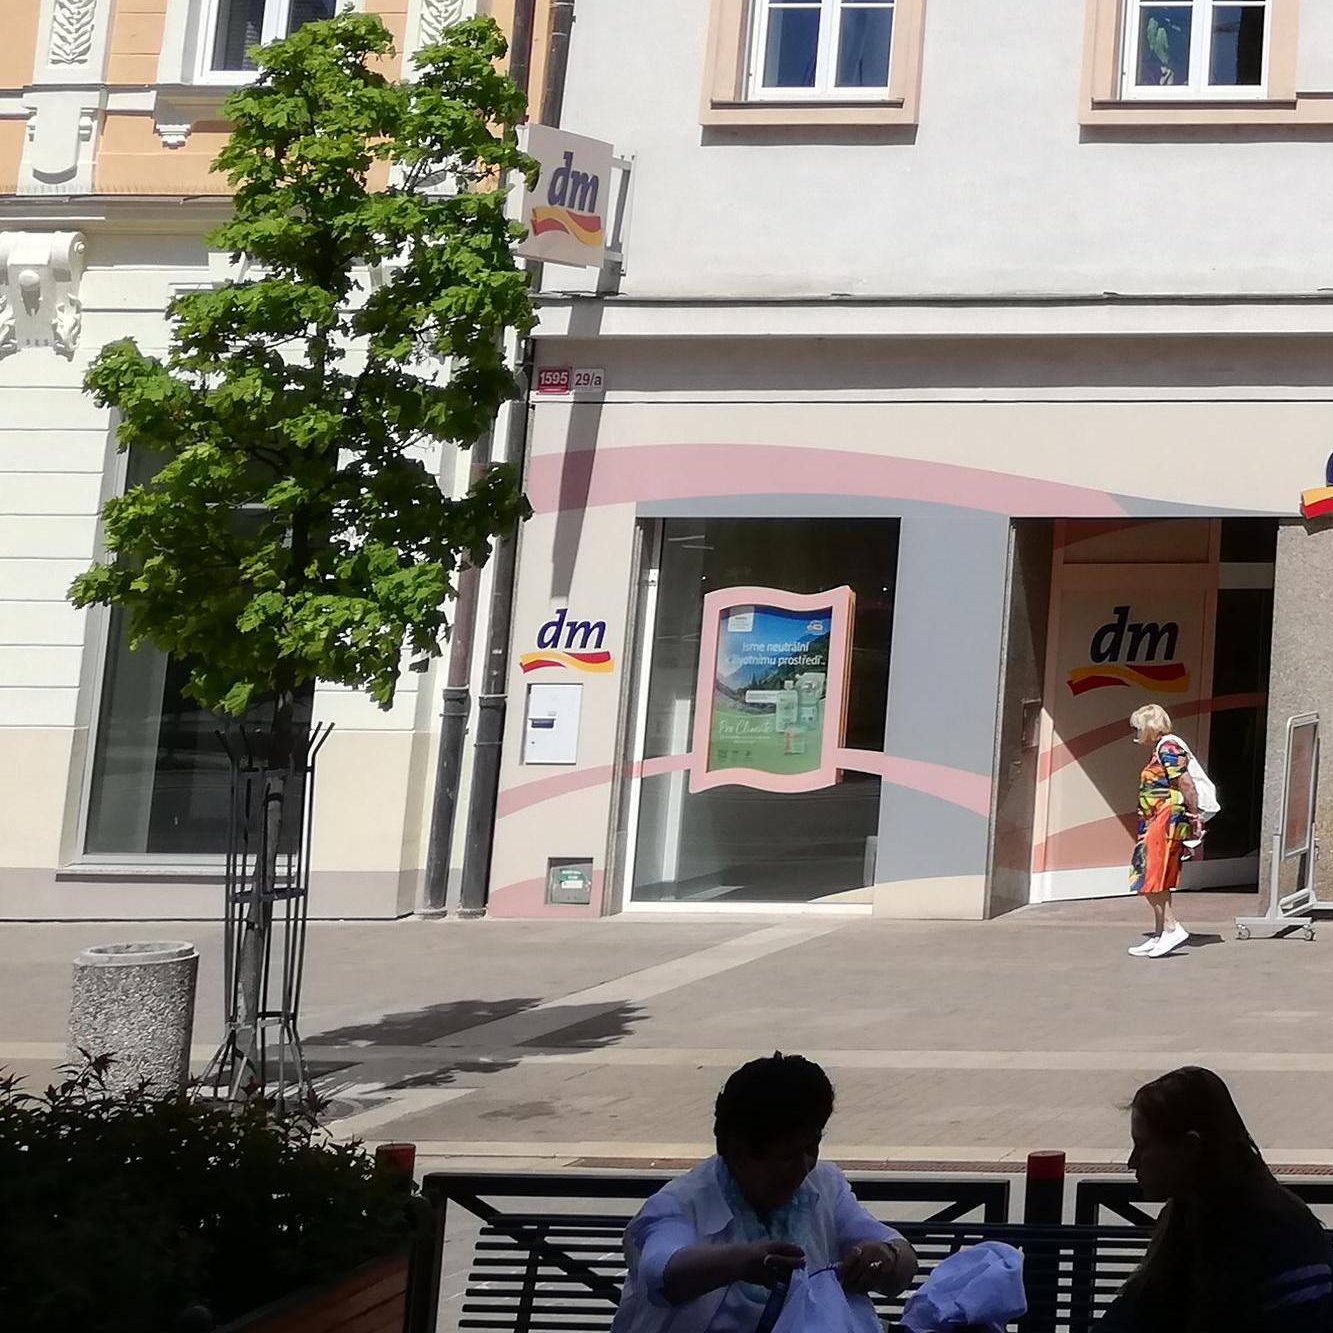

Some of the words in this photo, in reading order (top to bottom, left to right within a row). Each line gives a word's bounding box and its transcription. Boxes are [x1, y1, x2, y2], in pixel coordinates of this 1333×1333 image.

[548, 151, 599, 213] dm
[540, 371, 569, 385] 1595
[575, 373, 602, 386] 29/a
[537, 608, 606, 649] dm
[1090, 606, 1178, 663] dm
